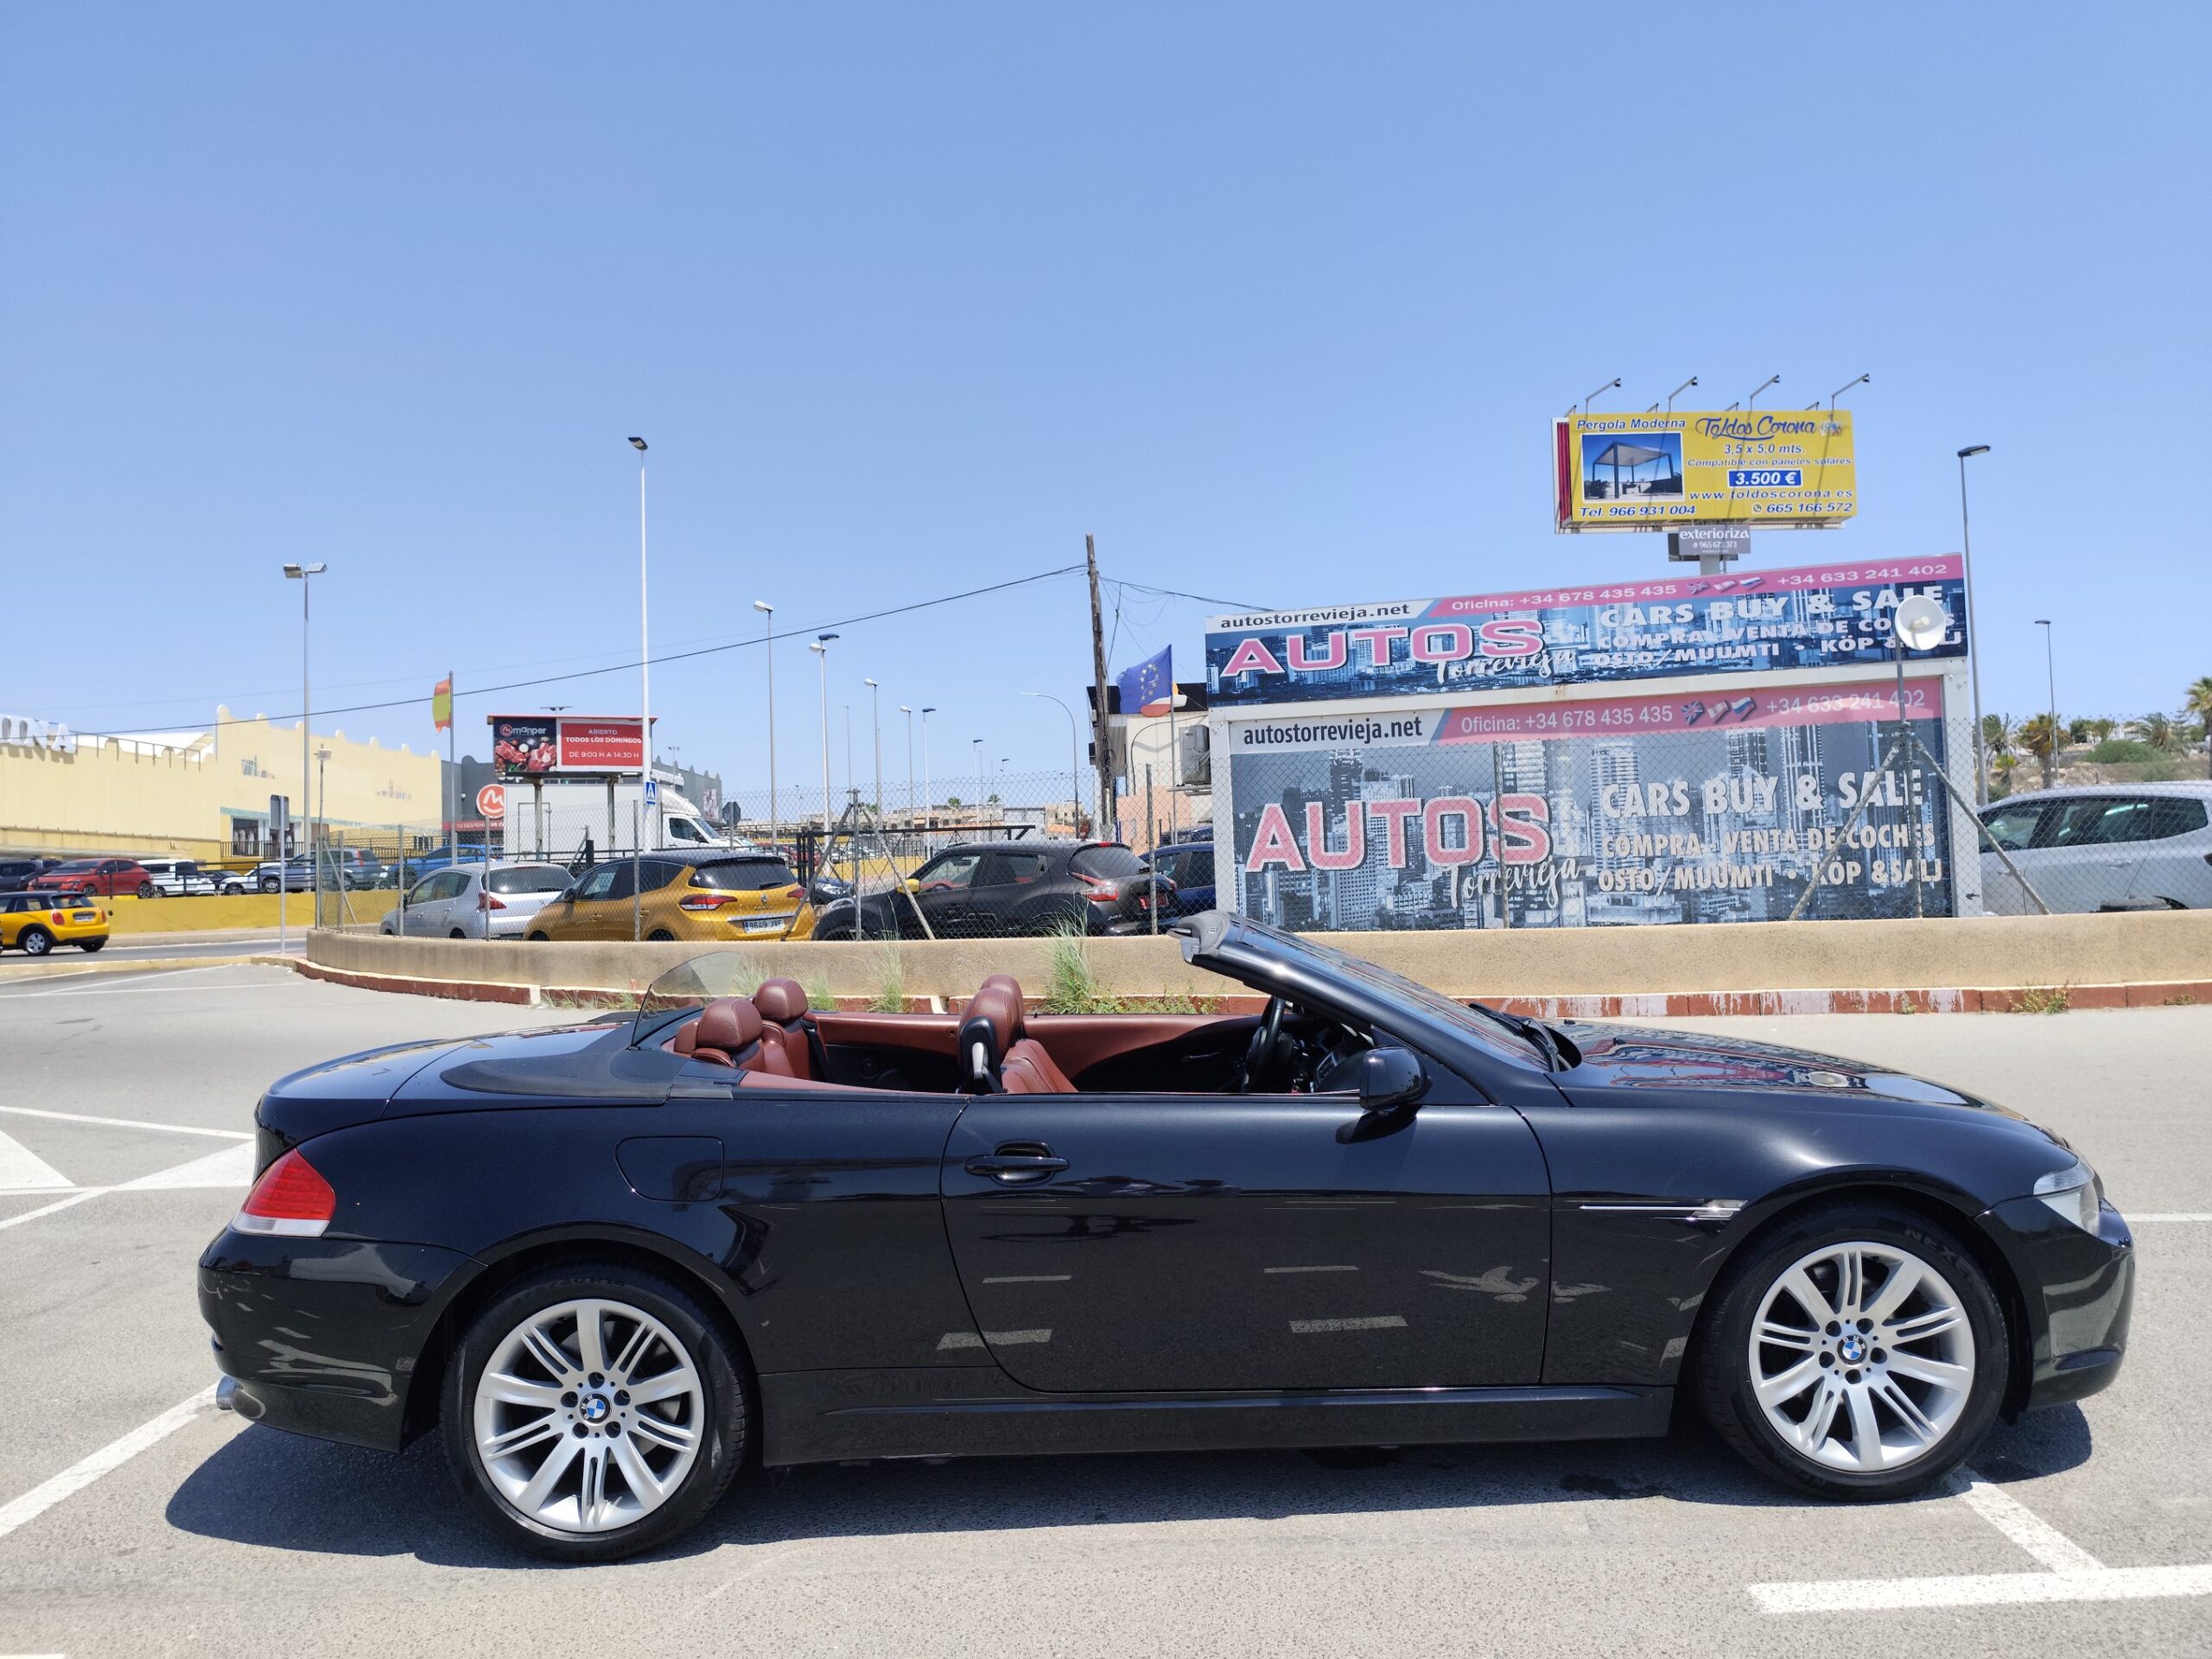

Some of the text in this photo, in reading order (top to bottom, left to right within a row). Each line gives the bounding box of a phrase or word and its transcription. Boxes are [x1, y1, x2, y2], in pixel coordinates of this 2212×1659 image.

[1630, 418, 1686, 429] Moderna
[1695, 415, 1815, 439] Toldos Corona
[1724, 443, 1743, 455] 3,5
[1757, 443, 1776, 454] 5,0
[1778, 443, 1805, 454] mts.
[1688, 459, 1746, 467] Compatible
[1771, 458, 1811, 467] paneles
[1814, 457, 1852, 466] solares
[1735, 471, 1796, 486] 3.500 €
[1689, 489, 1853, 500] www.toldoscorona.es
[1580, 505, 1696, 518] Tel. 966 931 004
[1766, 502, 1853, 513] 665 166 572
[1679, 527, 1750, 540] exterioriza
[1777, 563, 1948, 586] +34 633 241 402
[1220, 584, 1677, 629] autostorrevieja.net Oficina: +34 678 435 435
[1599, 603, 1694, 628] CARS
[1709, 596, 1789, 621] BUY
[1807, 594, 1836, 614] &
[1599, 629, 1706, 650] COMPRA
[1726, 621, 1809, 642] VENTA
[1817, 620, 1849, 635] DE
[1821, 634, 1874, 653] KÖP
[1220, 620, 1545, 678] AUTOS
[1766, 689, 1925, 715] +34 633 241 402
[512, 726, 547, 736] manper
[1243, 704, 1674, 746] autostorrevieja.net Oficina: +34 678 435 435
[1601, 768, 1924, 819] CARS BUY & SALE
[1244, 792, 1551, 874] AUTOS
[1602, 832, 1703, 858] COMPRA
[1725, 827, 1799, 855] VENTA
[1807, 826, 1837, 851] DE
[1442, 855, 1582, 909] Torrevieja
